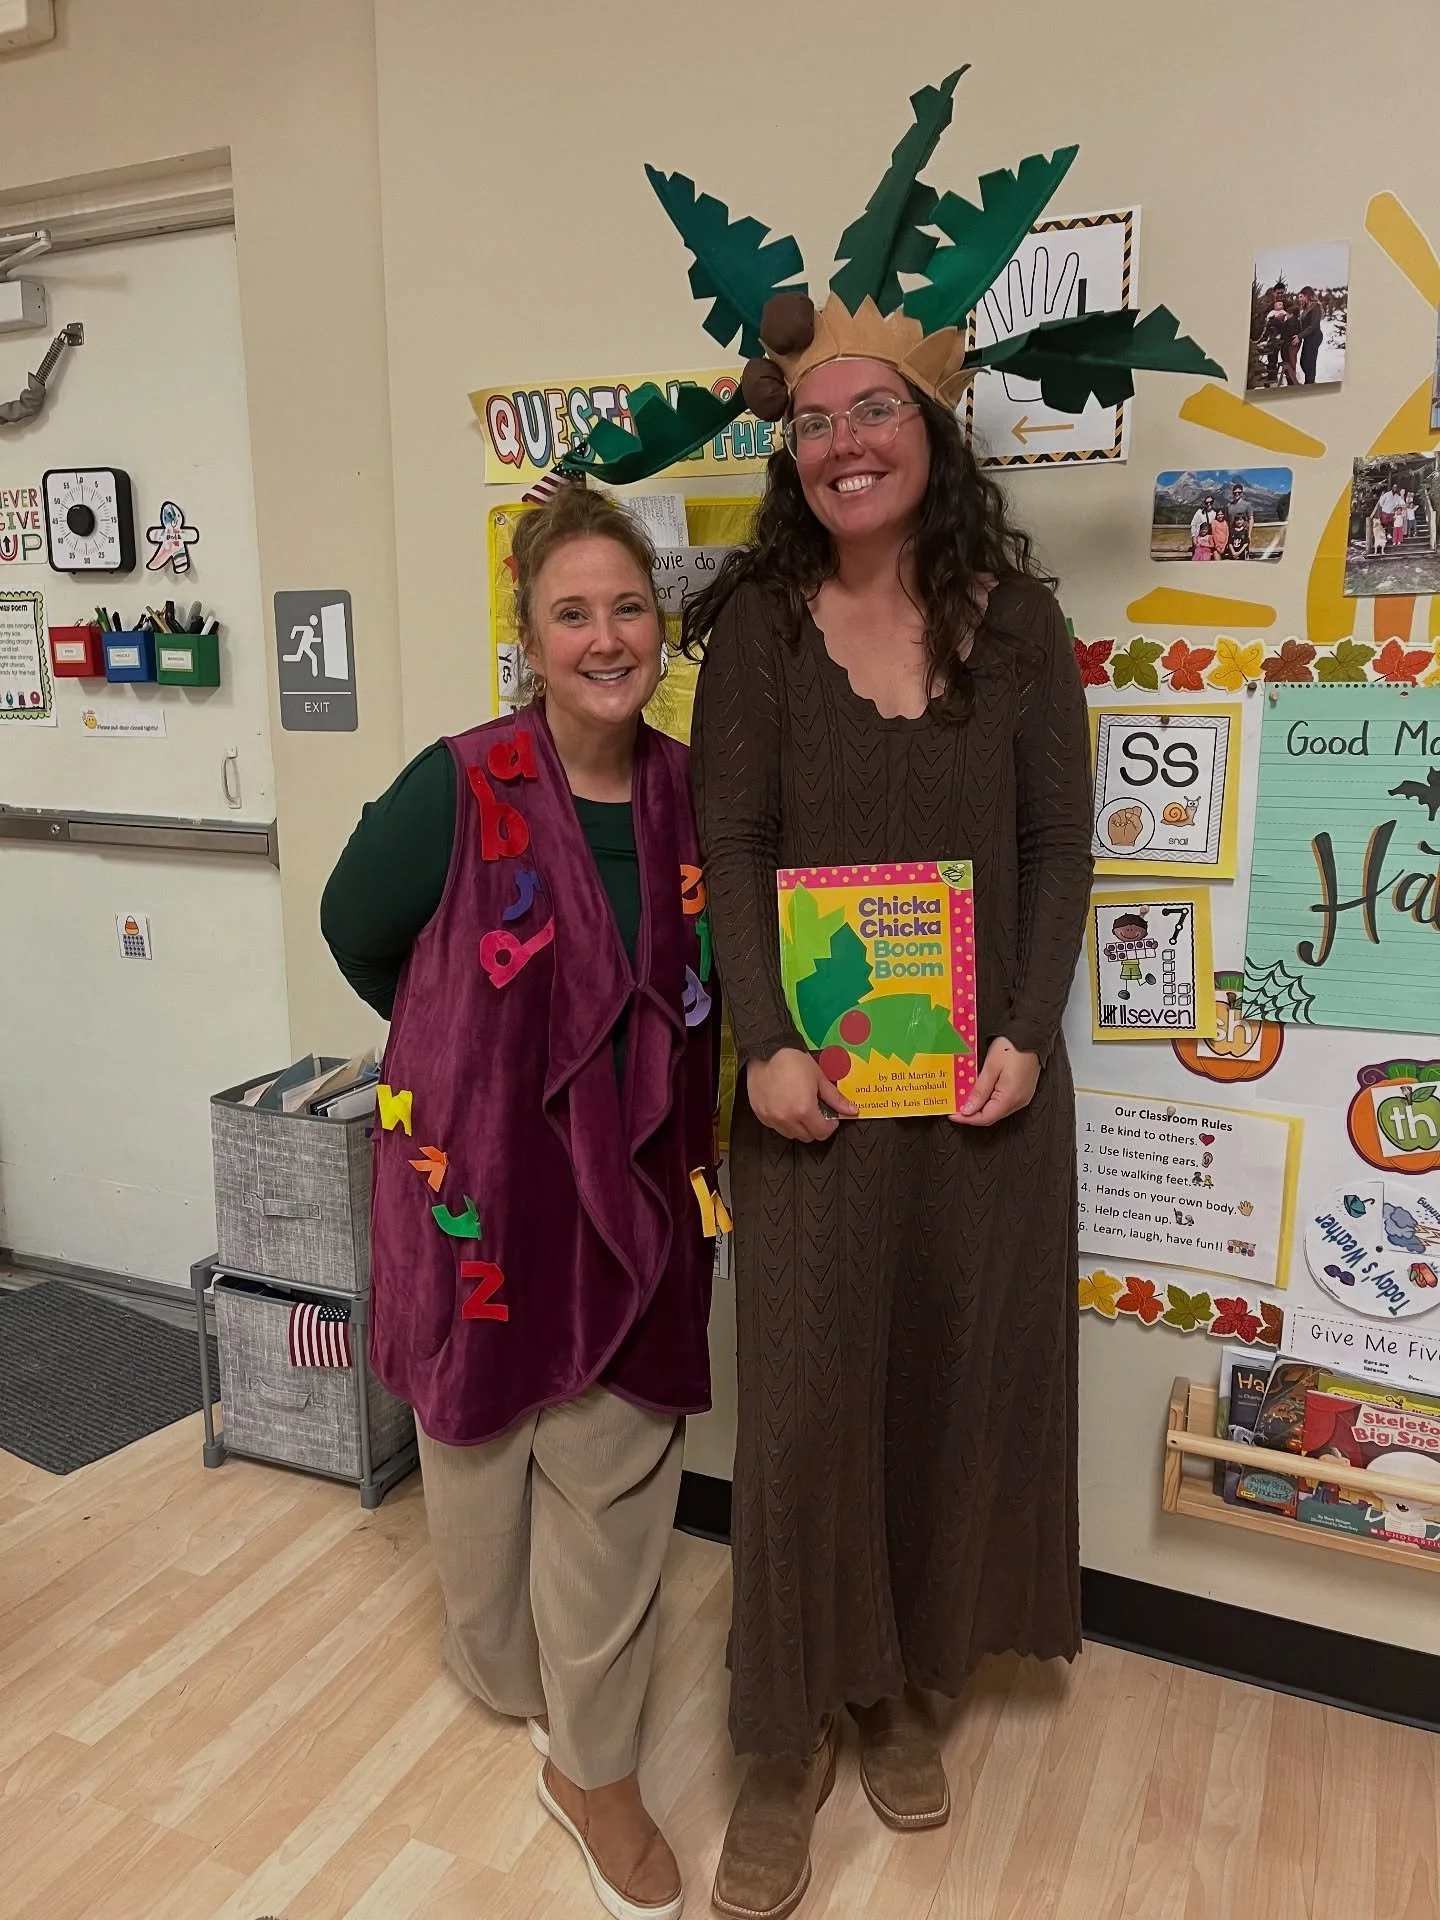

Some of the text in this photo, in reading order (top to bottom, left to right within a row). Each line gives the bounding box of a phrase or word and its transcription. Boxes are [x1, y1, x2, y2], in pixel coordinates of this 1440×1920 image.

[712, 420, 776, 461] THE
[0, 534, 42, 561] UP
[652, 551, 716, 570] ovie do
[657, 575, 689, 599] or?
[304, 701, 330, 713] EXIT
[1287, 720, 1370, 757] Good
[1119, 731, 1199, 787] Ss
[1168, 836, 1189, 846] snail
[858, 895, 941, 917] Chicka
[859, 917, 942, 938] Chicka
[1162, 907, 1189, 945] 7
[873, 939, 943, 958] Boom
[874, 960, 944, 979] Boom
[1126, 1009, 1191, 1026] seven
[855, 1081, 947, 1093] and John Archambault
[878, 1072, 888, 1082] by
[891, 1072, 905, 1081] Bill
[908, 1071, 936, 1080] Martin
[891, 1101, 900, 1109] by
[903, 1099, 920, 1107] Lois
[923, 1098, 948, 1106] Ehlert
[1115, 1106, 1233, 1131] Our Classroom Rules
[1390, 1104, 1438, 1140] th
[1086, 1122, 1198, 1146] 1. Be kind to others.
[1084, 1143, 1199, 1168] 2. Use listening ears.
[1082, 1163, 1192, 1187] 3. Use walking feet.
[1081, 1182, 1237, 1215] 4. Hands on your own body.
[1079, 1203, 1172, 1226] 5. Help clean up.
[1078, 1221, 1223, 1251] 6. Learn, laugh, have fun!!
[1314, 1213, 1411, 1316] Today's Weather
[1311, 1324, 1440, 1362] Give Me Fiv
[1354, 1427, 1440, 1448] Big Sne
